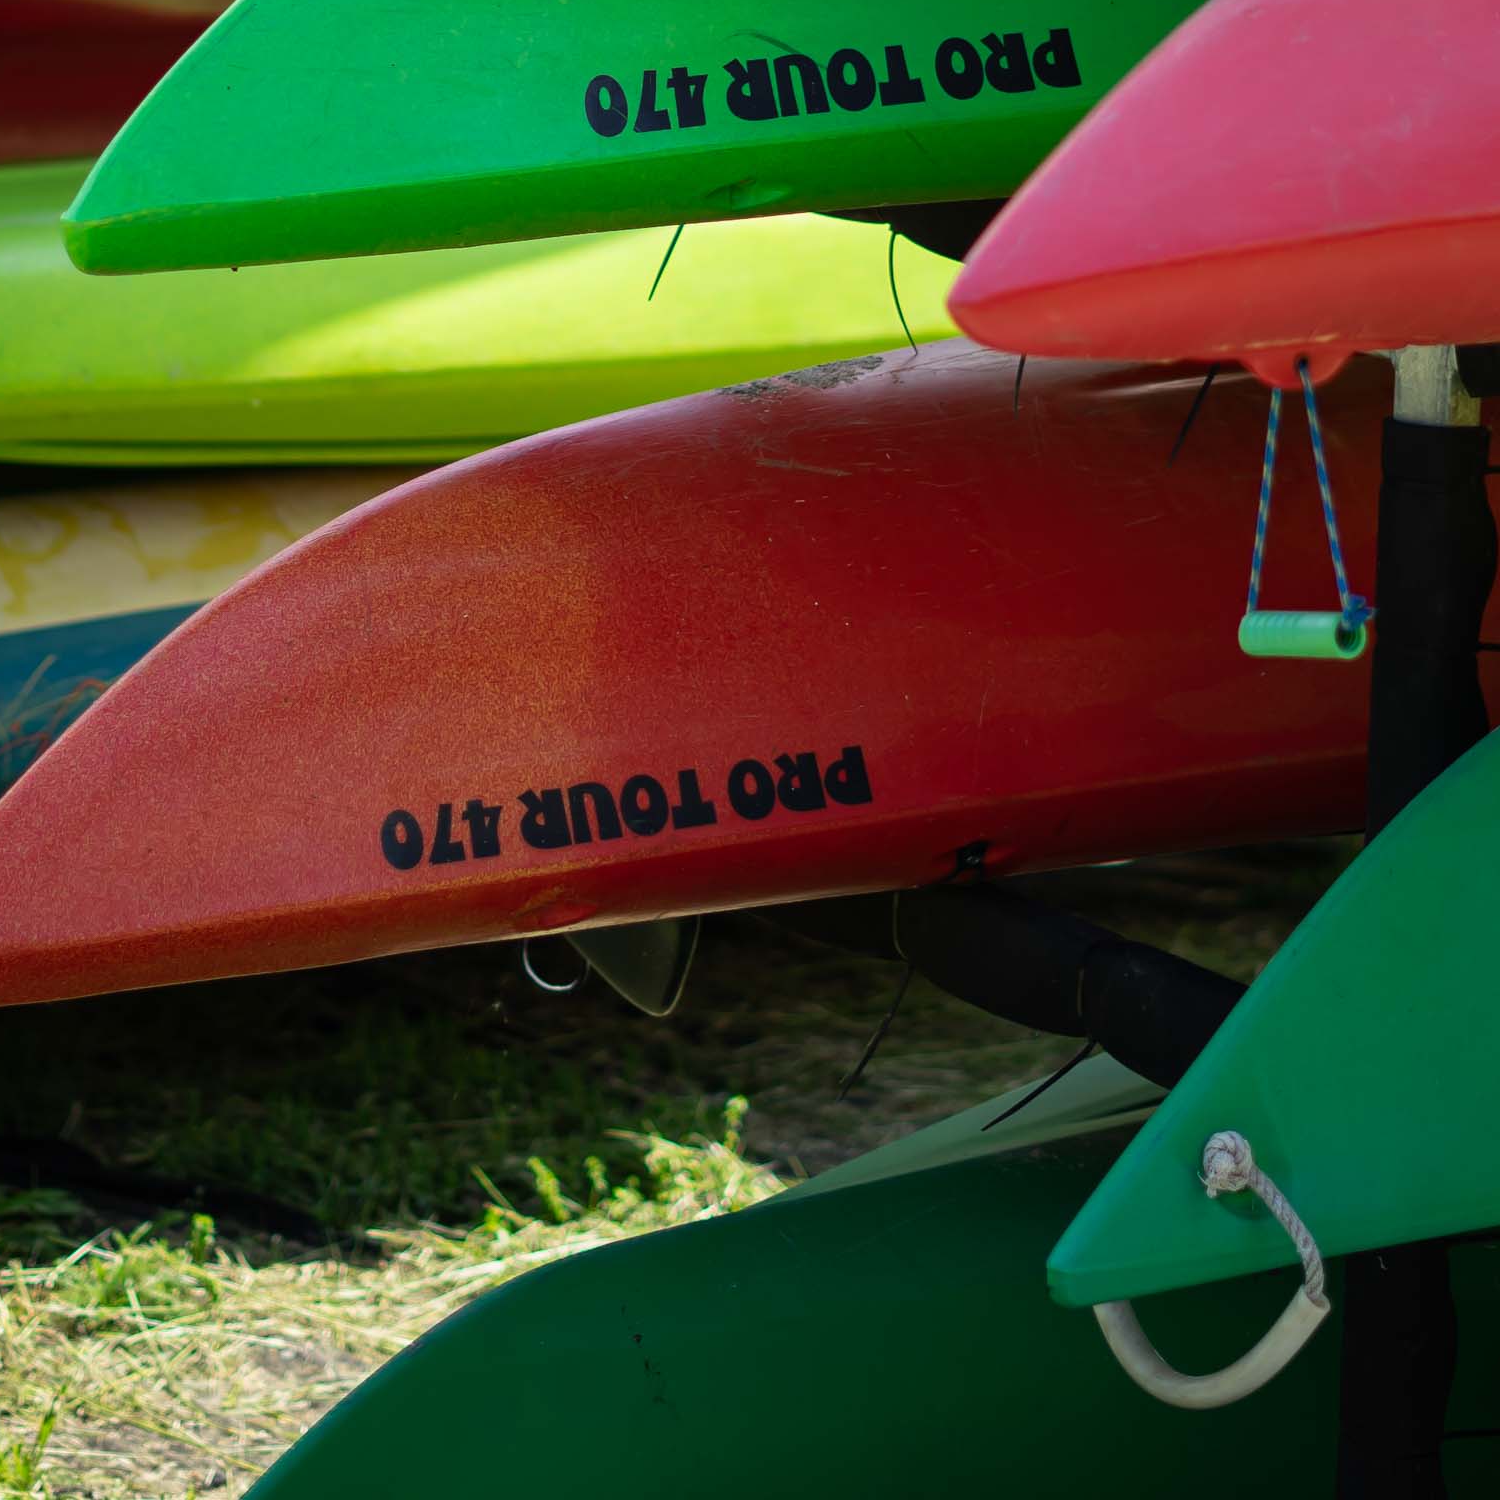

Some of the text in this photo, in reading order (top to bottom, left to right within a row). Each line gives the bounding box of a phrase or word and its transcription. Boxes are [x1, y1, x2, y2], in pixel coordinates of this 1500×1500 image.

[585, 27, 1083, 138] PRO TOUR 470
[382, 745, 873, 871] PRO TOUR 470
